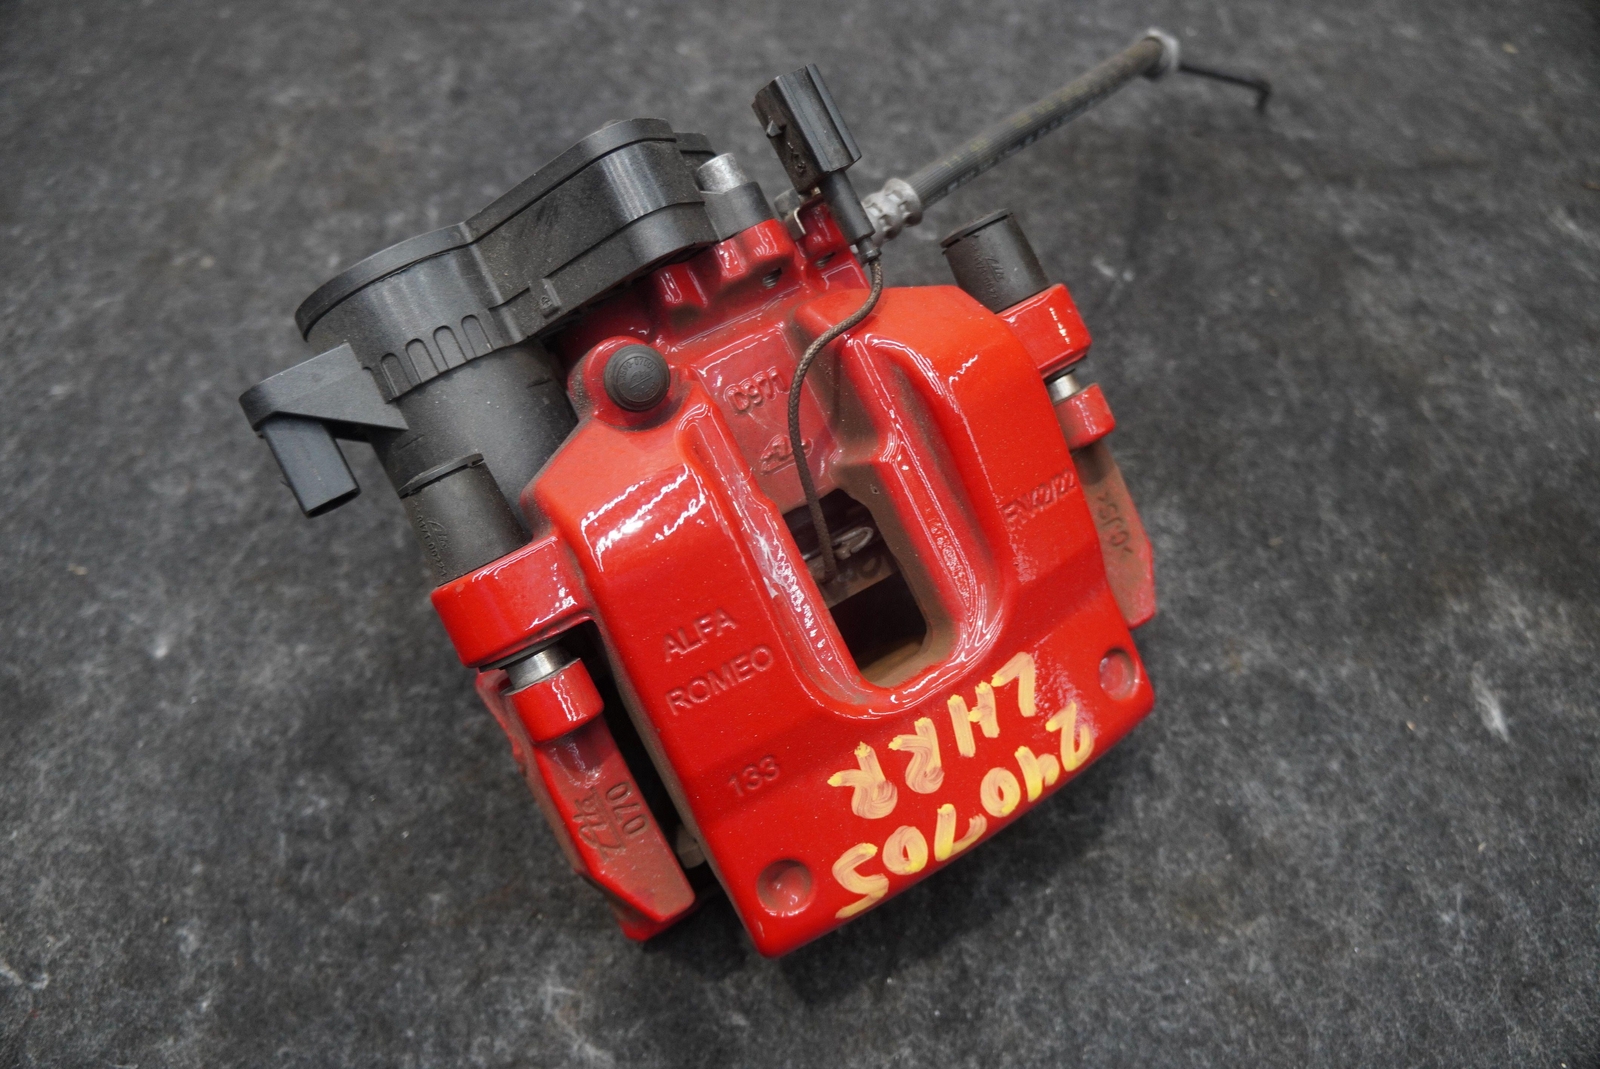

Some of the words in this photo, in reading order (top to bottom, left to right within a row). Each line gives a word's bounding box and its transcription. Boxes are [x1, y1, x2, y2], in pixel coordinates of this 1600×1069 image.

[662, 607, 737, 664] ALFA
[664, 644, 774, 716] ROMEO
[827, 651, 1037, 820] LHRR
[728, 753, 781, 799] 133
[832, 700, 1095, 919] 240705
